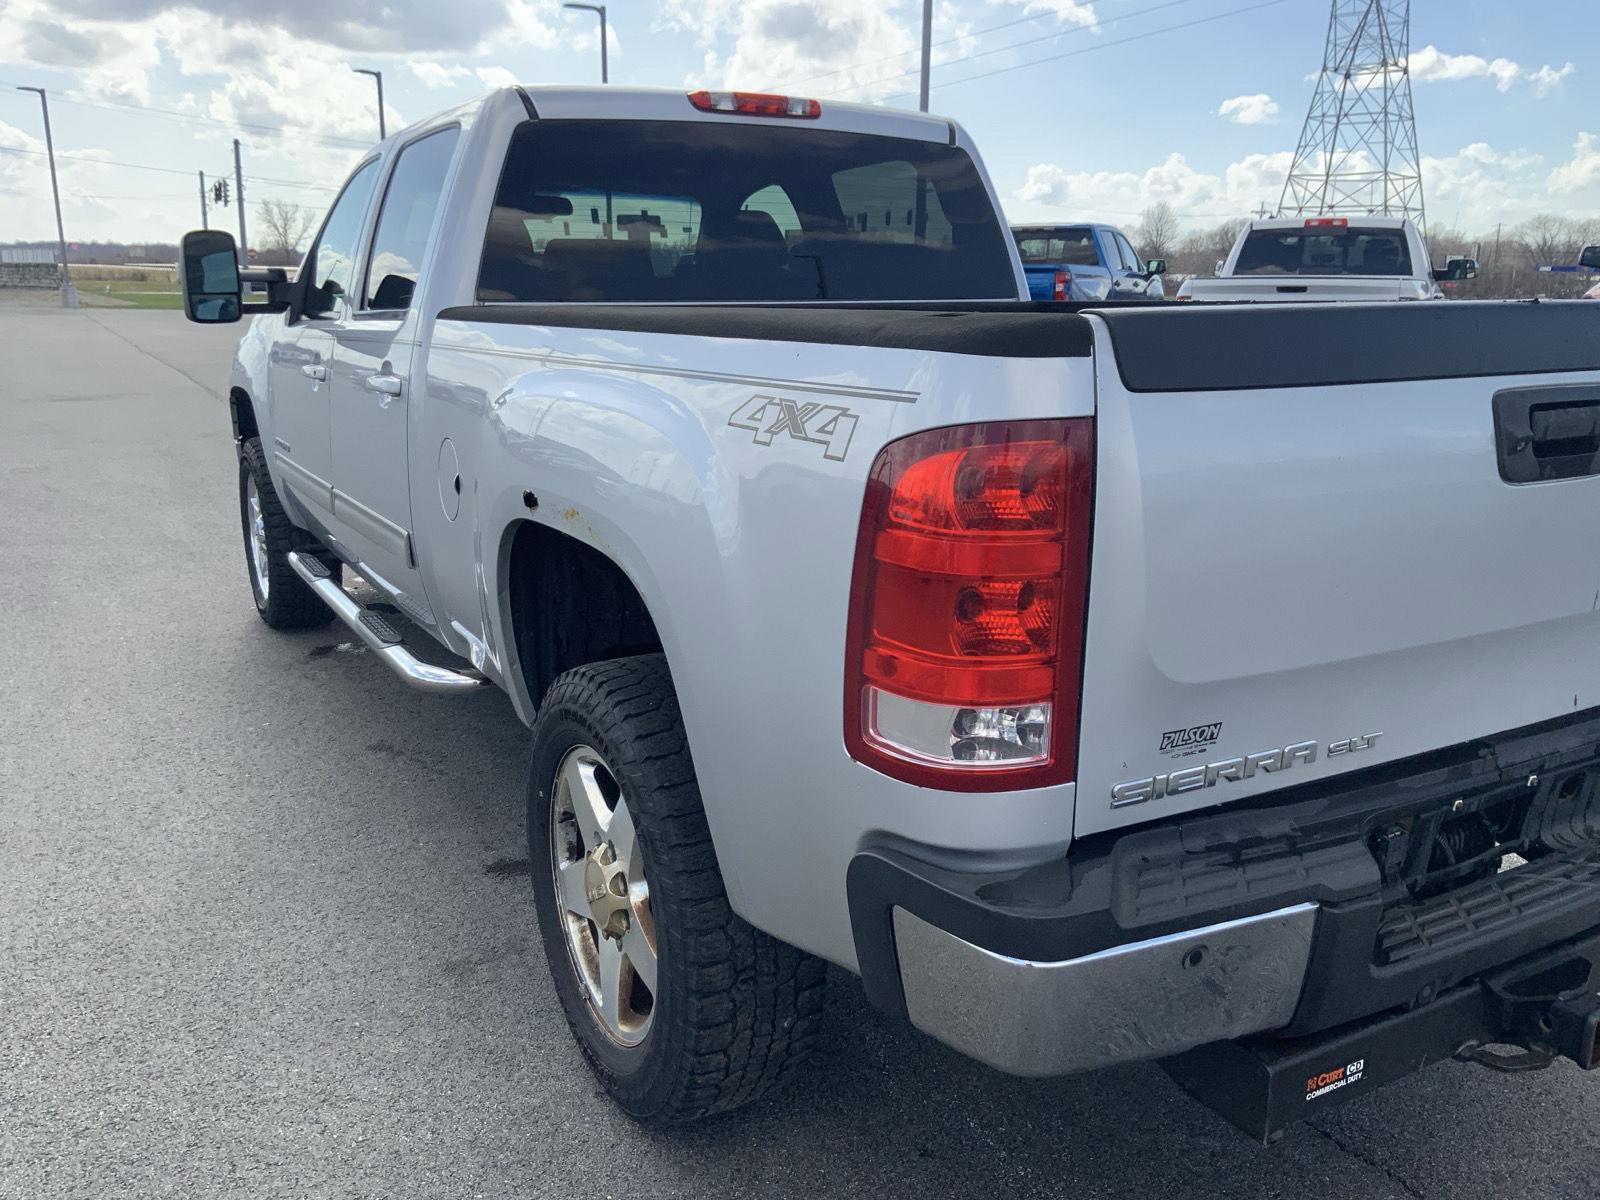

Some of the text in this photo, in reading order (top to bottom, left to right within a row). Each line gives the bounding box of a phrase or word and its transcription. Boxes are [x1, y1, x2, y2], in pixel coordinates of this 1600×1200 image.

[1160, 722, 1222, 750] PILSON
[1110, 732, 1383, 809] SIERRA SLT
[1305, 1072, 1363, 1100] COMMERCIAL DUTY
